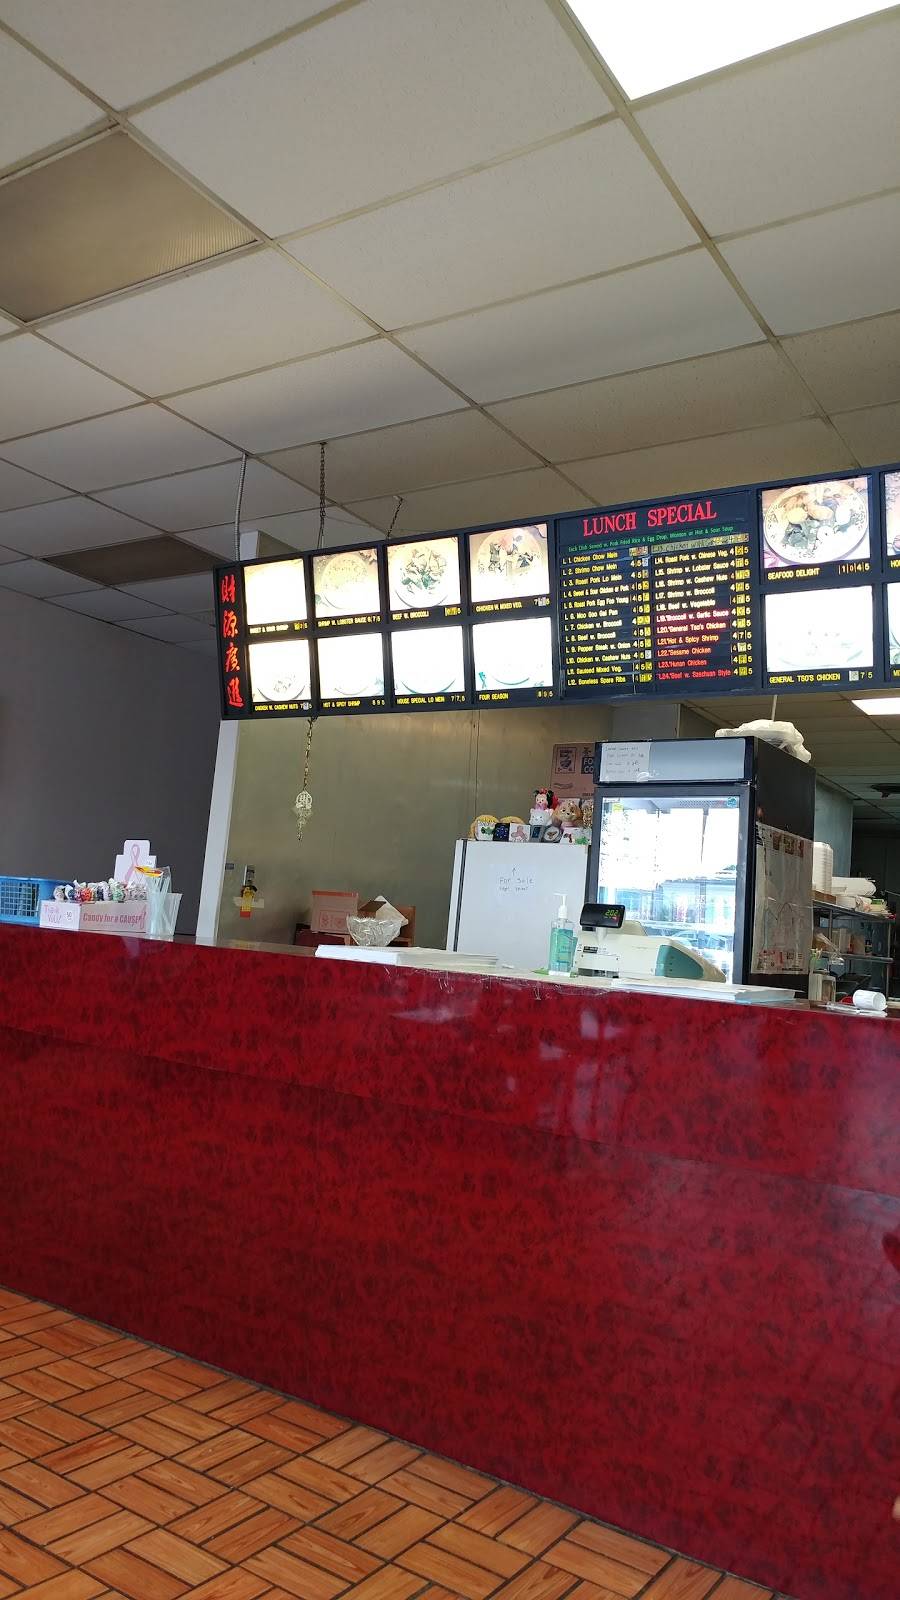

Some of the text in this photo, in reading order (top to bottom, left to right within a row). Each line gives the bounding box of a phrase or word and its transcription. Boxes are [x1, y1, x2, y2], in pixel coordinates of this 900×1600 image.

[583, 501, 717, 537] LUNCH SPECIAL
[768, 570, 794, 580] SEAFOOD
[796, 567, 820, 577] DELIGHT
[685, 635, 699, 643] Spicy
[770, 676, 794, 684] GENERAL
[817, 673, 840, 681] CHICKEN
[479, 693, 491, 701] FOUR
